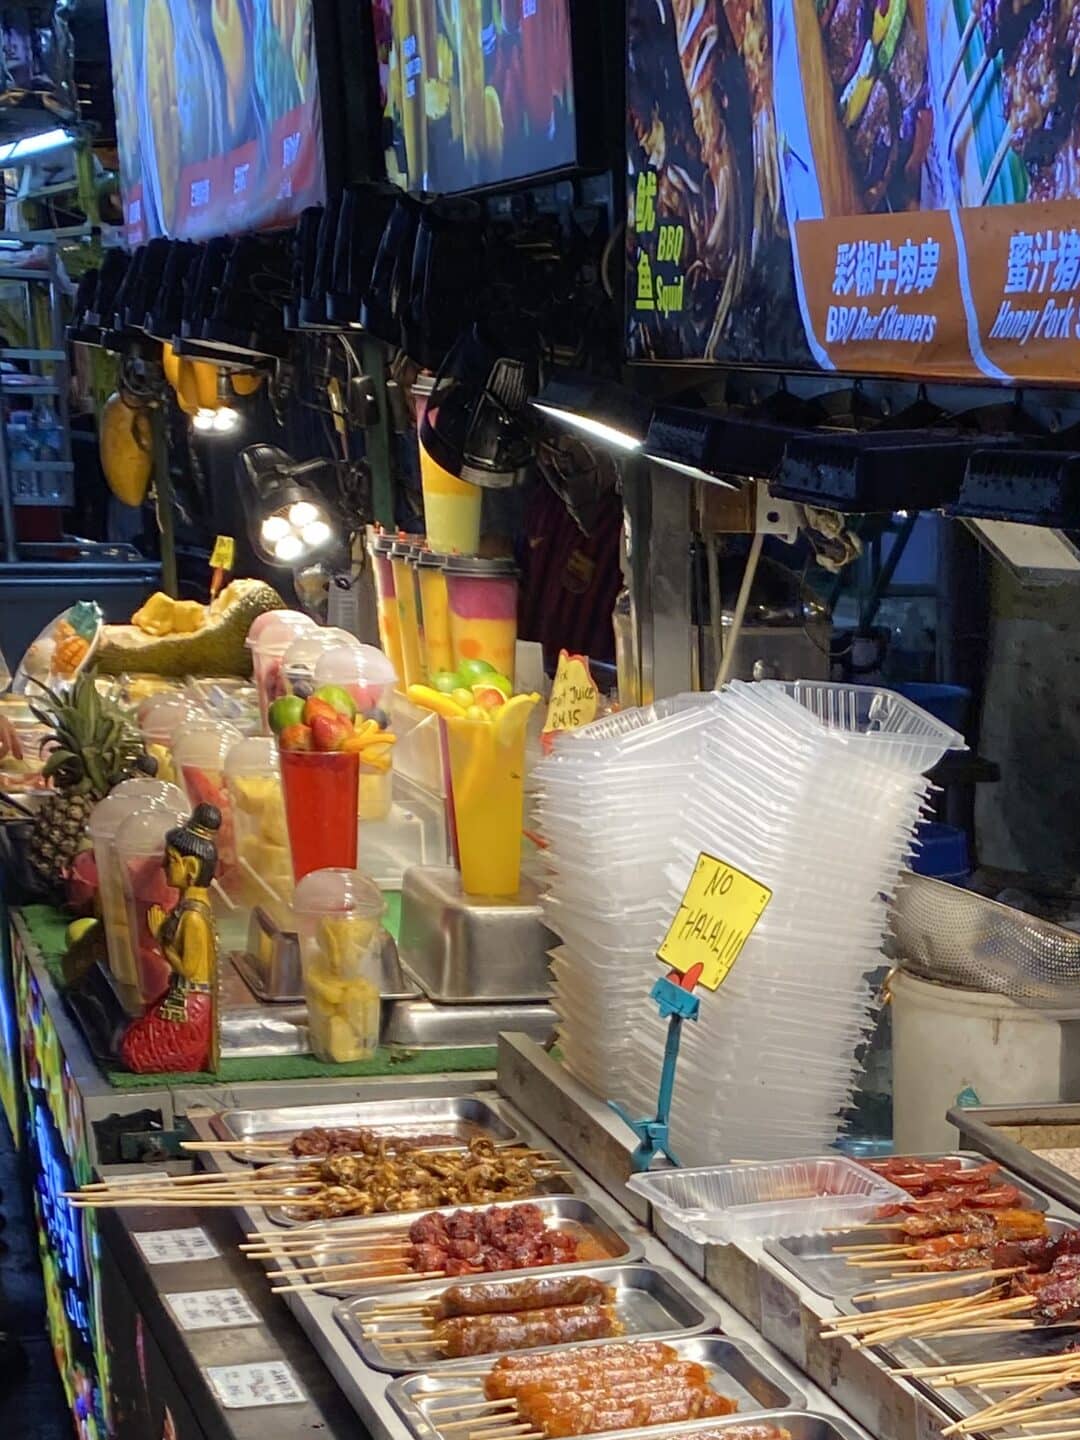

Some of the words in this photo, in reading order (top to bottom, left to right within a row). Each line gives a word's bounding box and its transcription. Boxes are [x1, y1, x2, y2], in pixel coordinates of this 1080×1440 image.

[657, 225, 684, 266] BBQ
[656, 274, 684, 319] Squid
[826, 305, 853, 344] BBQ
[853, 306, 885, 342] Beef
[879, 305, 937, 342] Skewers
[989, 300, 1041, 345] Honey
[1035, 298, 1074, 339] Pork
[703, 866, 734, 897] NO
